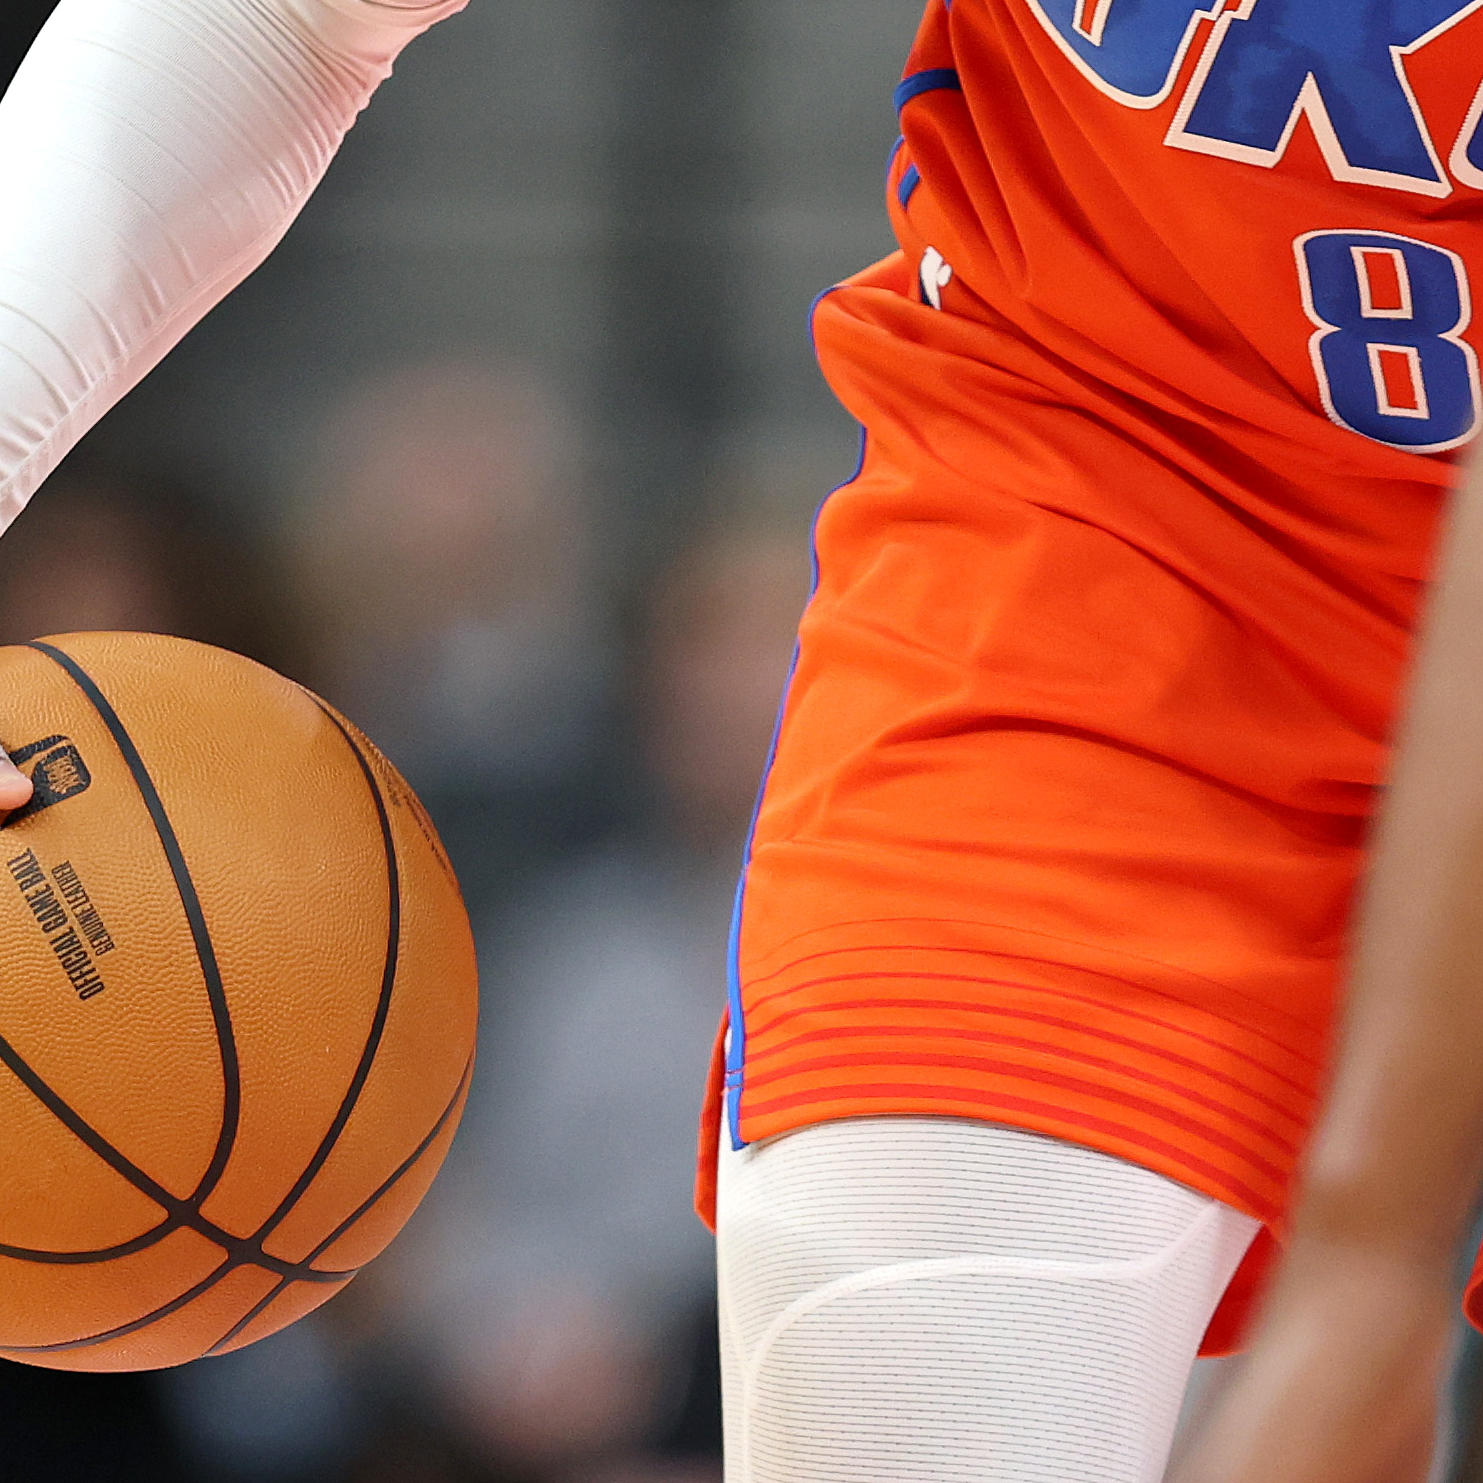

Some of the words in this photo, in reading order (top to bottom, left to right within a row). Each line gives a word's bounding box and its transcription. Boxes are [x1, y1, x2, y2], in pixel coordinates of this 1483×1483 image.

[1293, 228, 1482, 454] 8
[7, 847, 46, 892] BALL
[52, 860, 90, 912] LEATHER
[25, 883, 68, 933] GAME
[75, 904, 115, 956] GENUINE
[49, 926, 105, 1000] OFFICIAL
